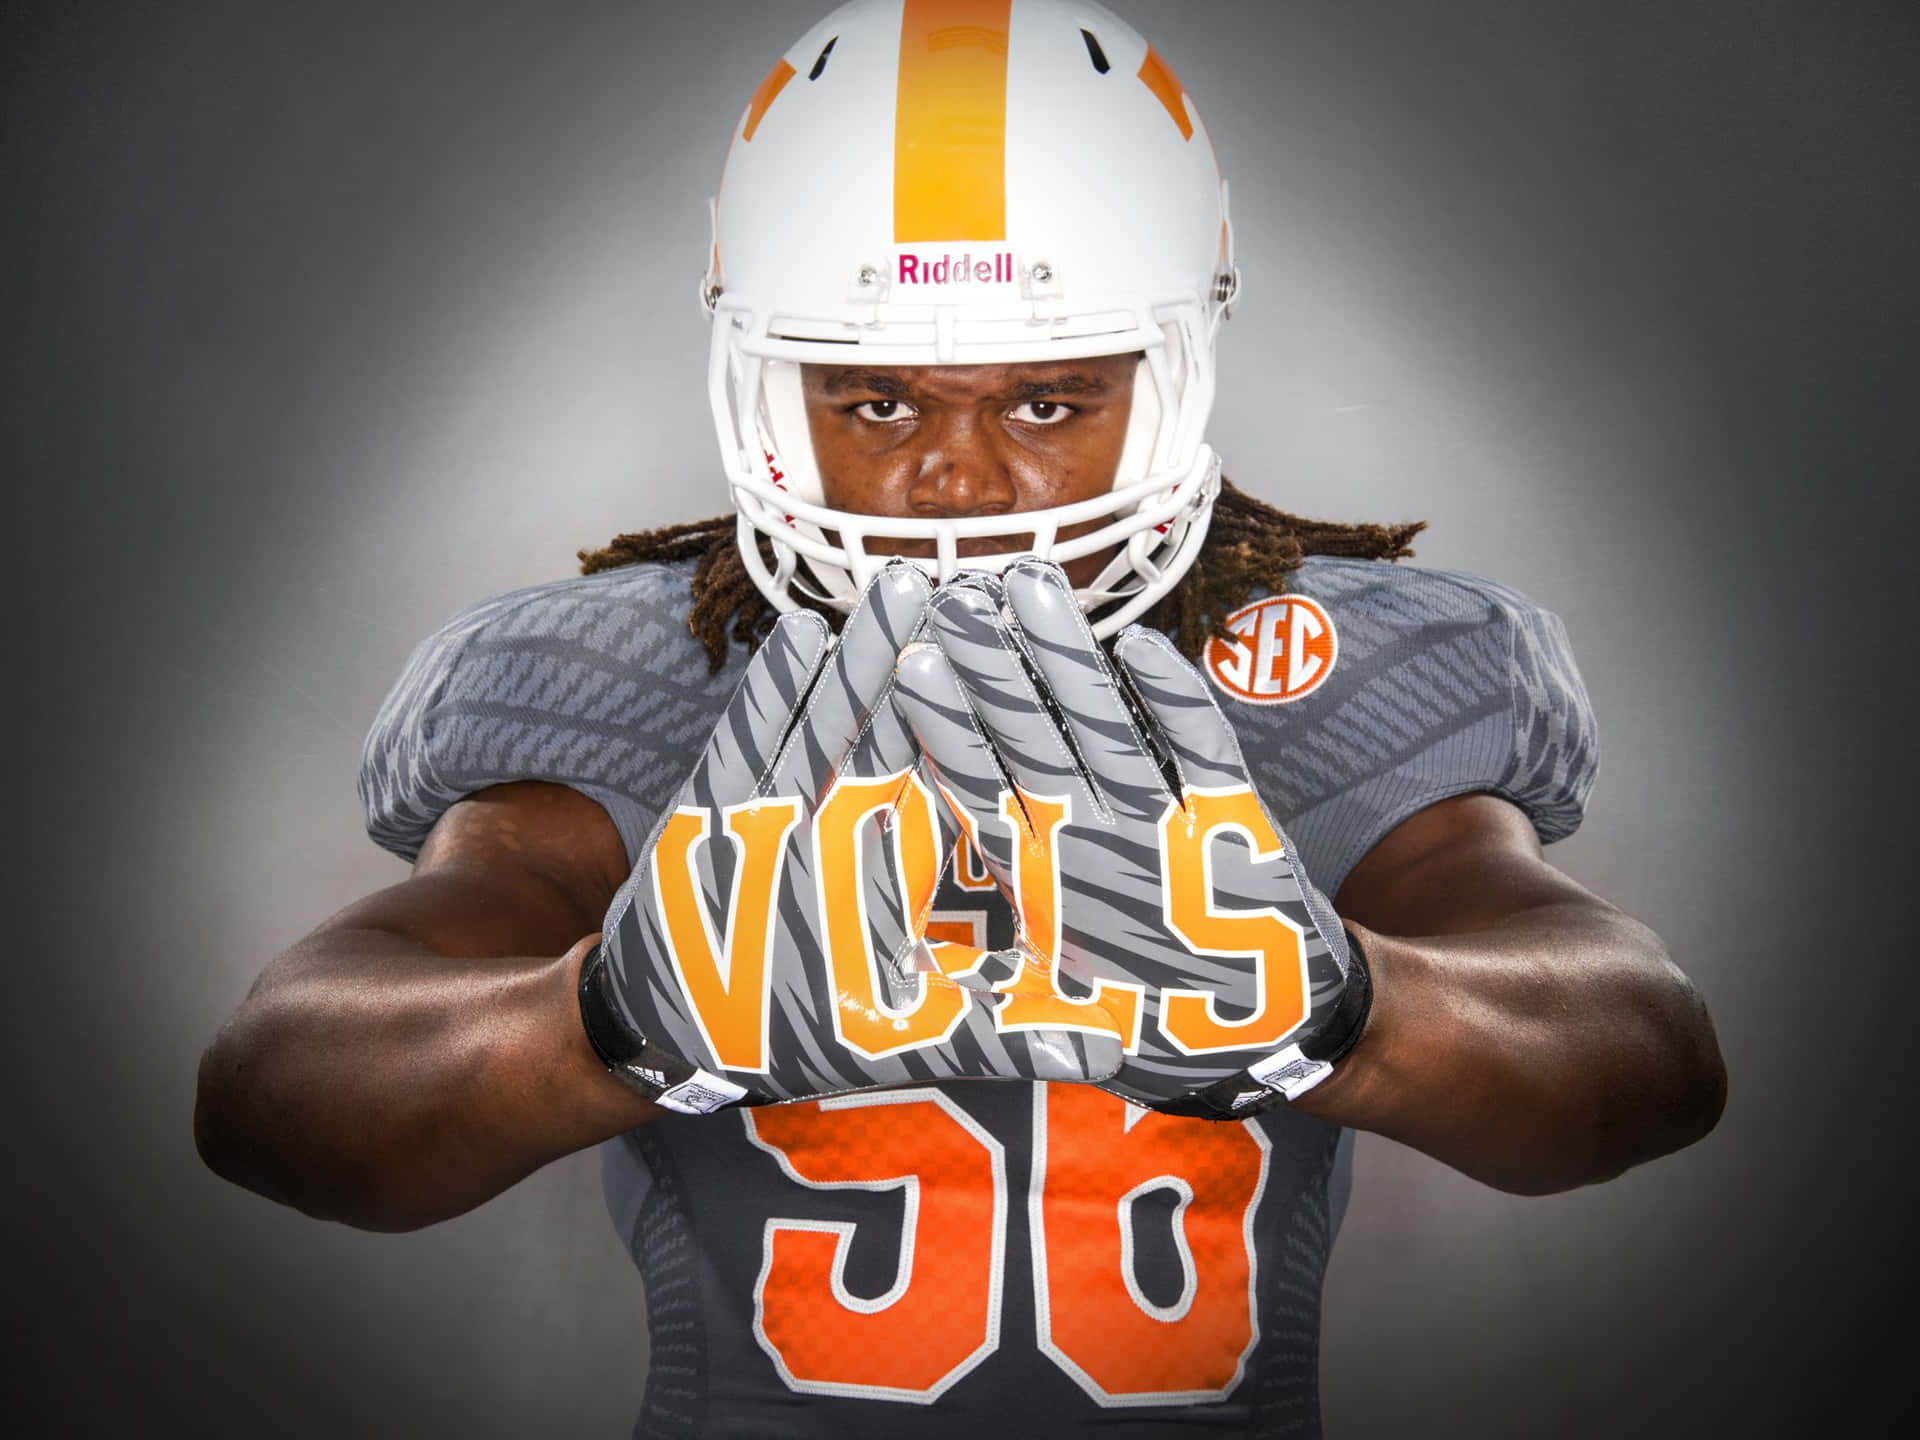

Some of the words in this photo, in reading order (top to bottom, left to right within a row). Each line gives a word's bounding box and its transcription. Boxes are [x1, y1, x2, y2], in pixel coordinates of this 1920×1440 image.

[899, 252, 1012, 284] Riddell
[1217, 603, 1324, 695] SEC
[650, 768, 1311, 1074] VOLS
[740, 1080, 1272, 1408] 56
